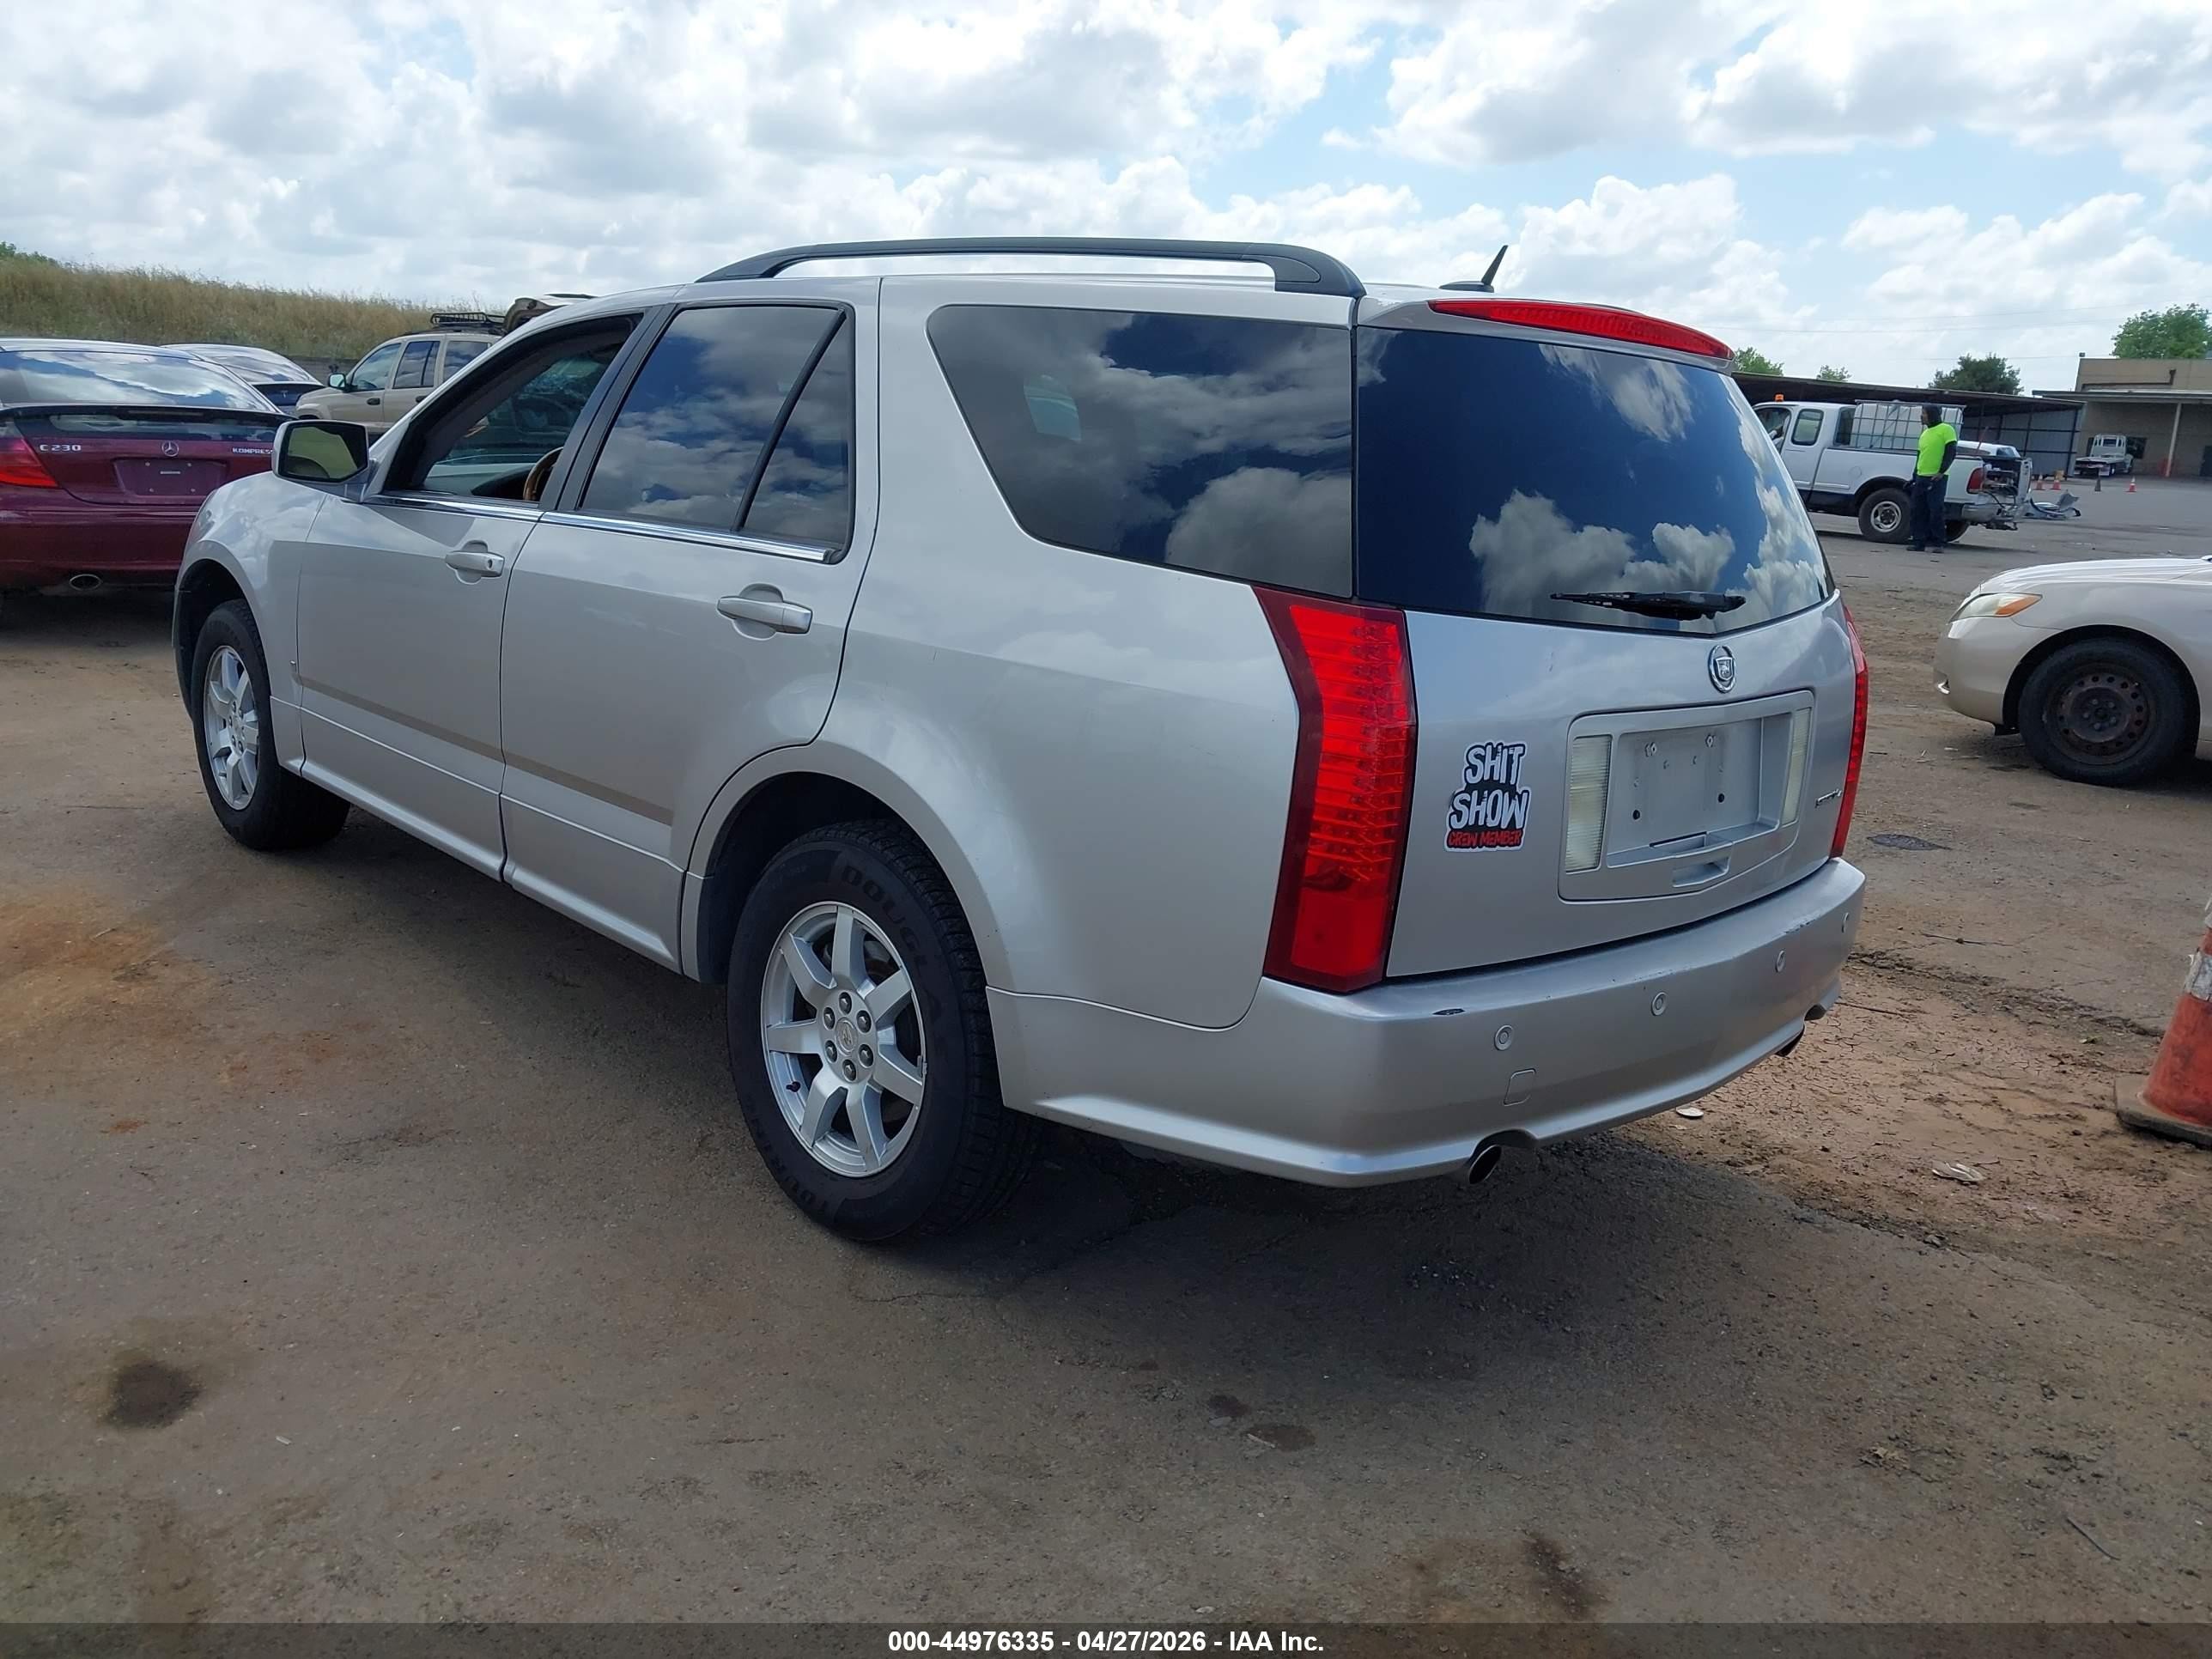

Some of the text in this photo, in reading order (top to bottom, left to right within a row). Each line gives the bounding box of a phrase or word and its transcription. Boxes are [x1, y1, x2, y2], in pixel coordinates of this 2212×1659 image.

[1465, 744, 1524, 785] SHIT
[1450, 789, 1528, 829] SHOW
[1449, 830, 1522, 848] CREW MEMBER
